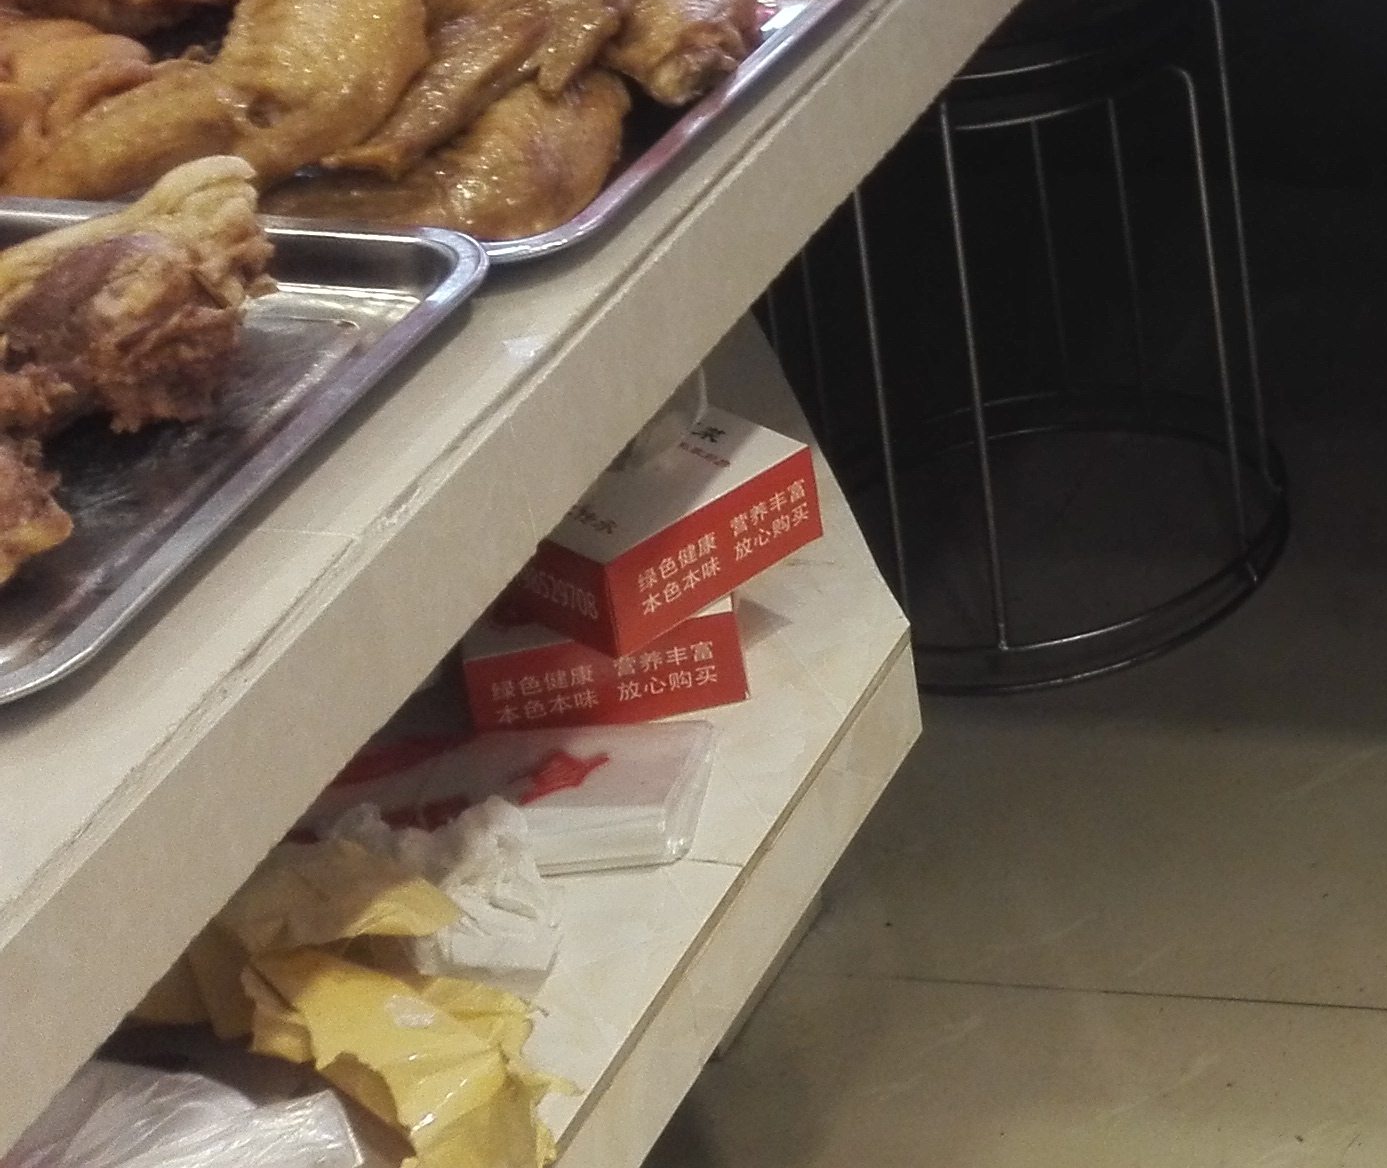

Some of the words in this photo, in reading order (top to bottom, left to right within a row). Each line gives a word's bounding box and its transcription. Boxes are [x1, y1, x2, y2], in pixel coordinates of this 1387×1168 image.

[637, 531, 718, 593] 绿色健康
[729, 479, 807, 538] 营养丰富
[641, 557, 722, 616] 本色本味
[733, 502, 810, 562] 放心购买
[491, 664, 594, 701] 绿色健康
[613, 640, 714, 678] 营养丰富
[496, 689, 600, 725] 本色本味
[618, 665, 718, 702] 放心购买
